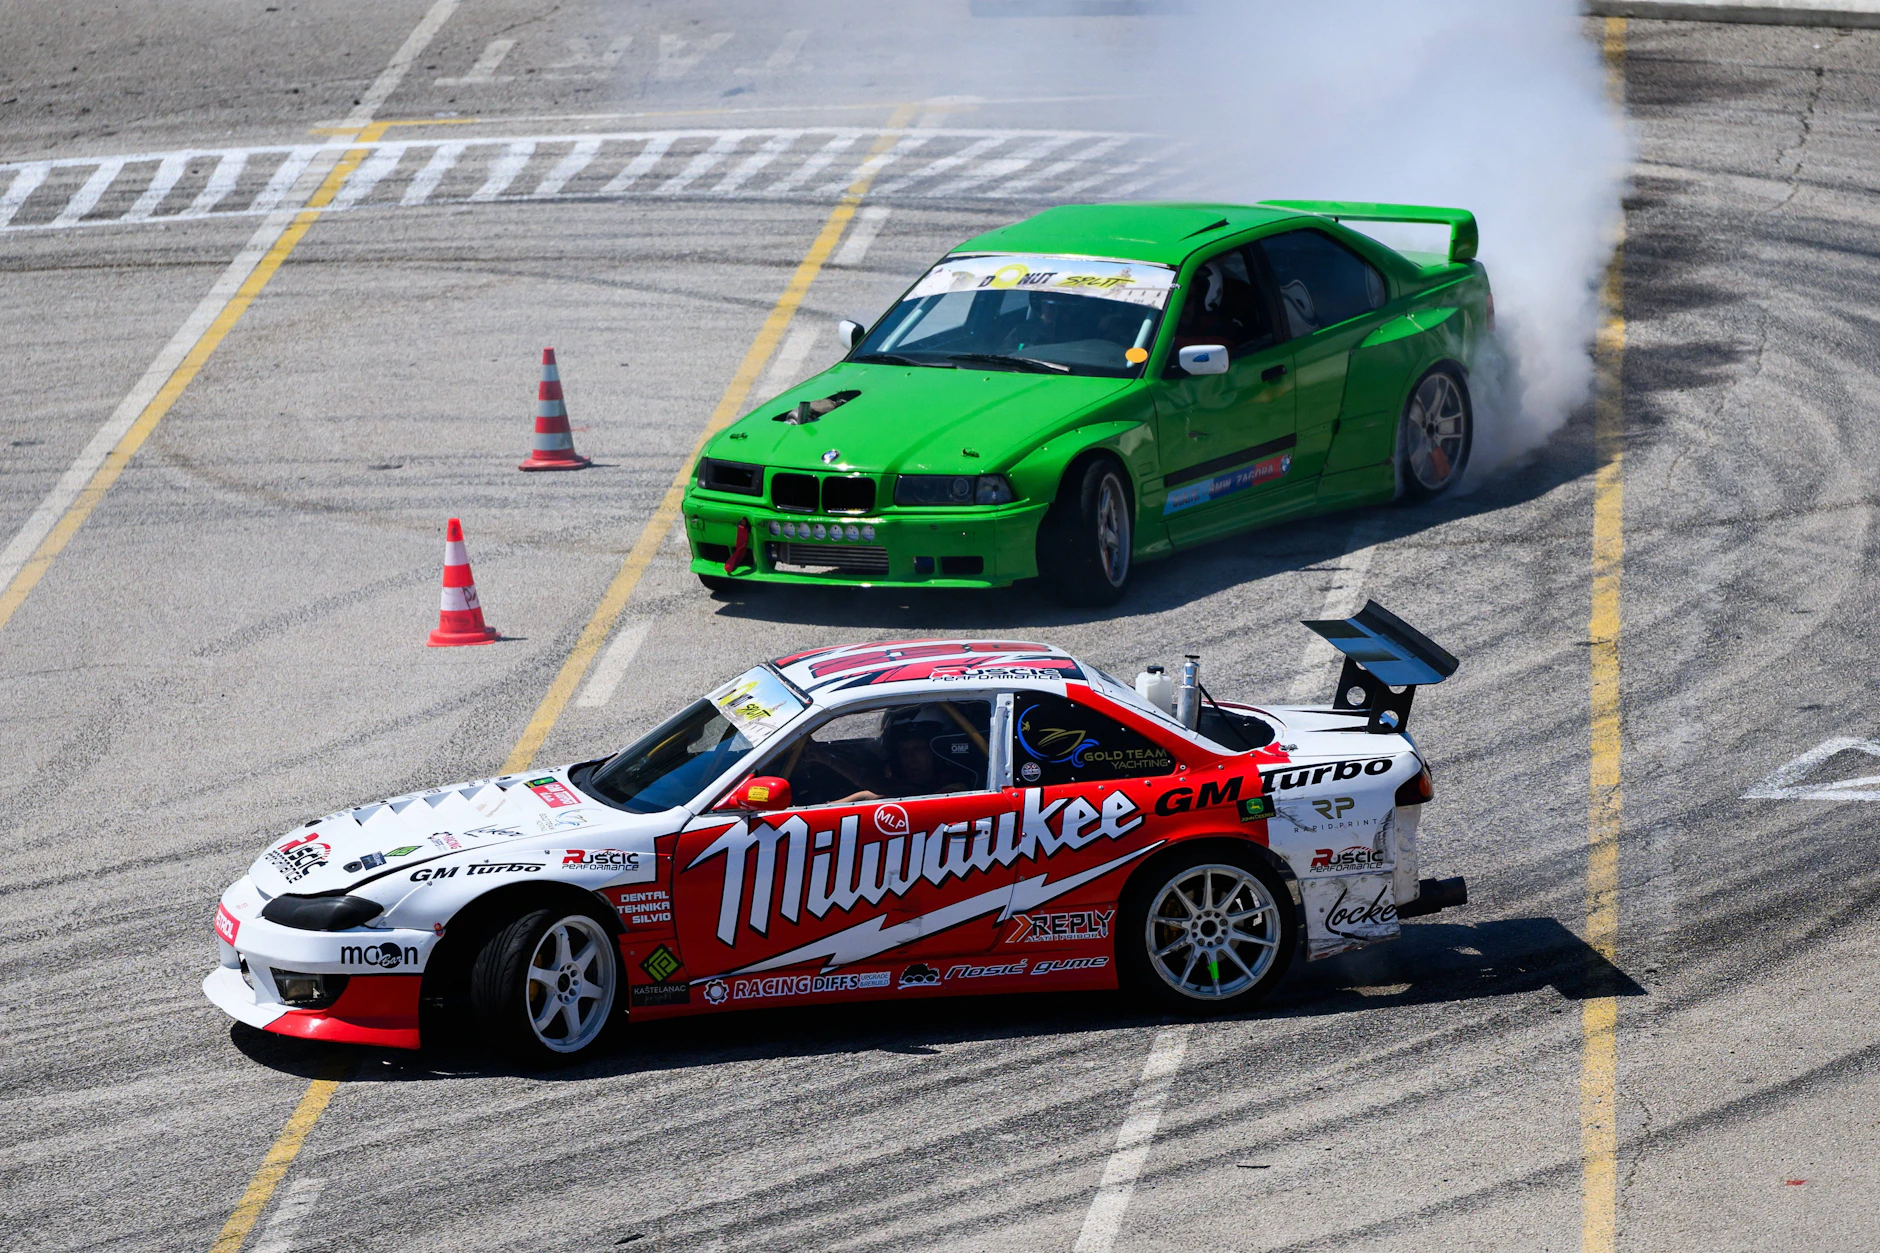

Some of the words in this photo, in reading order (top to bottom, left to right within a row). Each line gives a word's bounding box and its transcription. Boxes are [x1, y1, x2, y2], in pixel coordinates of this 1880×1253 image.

[951, 744, 969, 752] OMP
[1084, 750, 1123, 762] GOLD
[1128, 748, 1167, 759] TEAM
[1110, 758, 1168, 770] YACHTING
[1154, 776, 1245, 817] GM
[1311, 797, 1355, 820] RP
[876, 808, 907, 831] MLP
[1294, 823, 1333, 833] RAPID
[1339, 818, 1378, 829] PRINT
[409, 866, 460, 882] GM
[561, 863, 640, 872] PERFORMANCE
[1309, 862, 1383, 873] PERFORMANCE
[621, 890, 670, 903] DENTAL
[616, 901, 671, 914] TEHNIKA
[632, 912, 671, 924] SILVIO
[1032, 909, 1116, 939] REPLY
[380, 953, 403, 967] Bar
[1030, 956, 1110, 976] gume
[860, 972, 890, 981] UPGRADE
[633, 984, 686, 995] KAŠTELANAC
[733, 976, 811, 999] RACING
[812, 974, 859, 992] DIFFS
